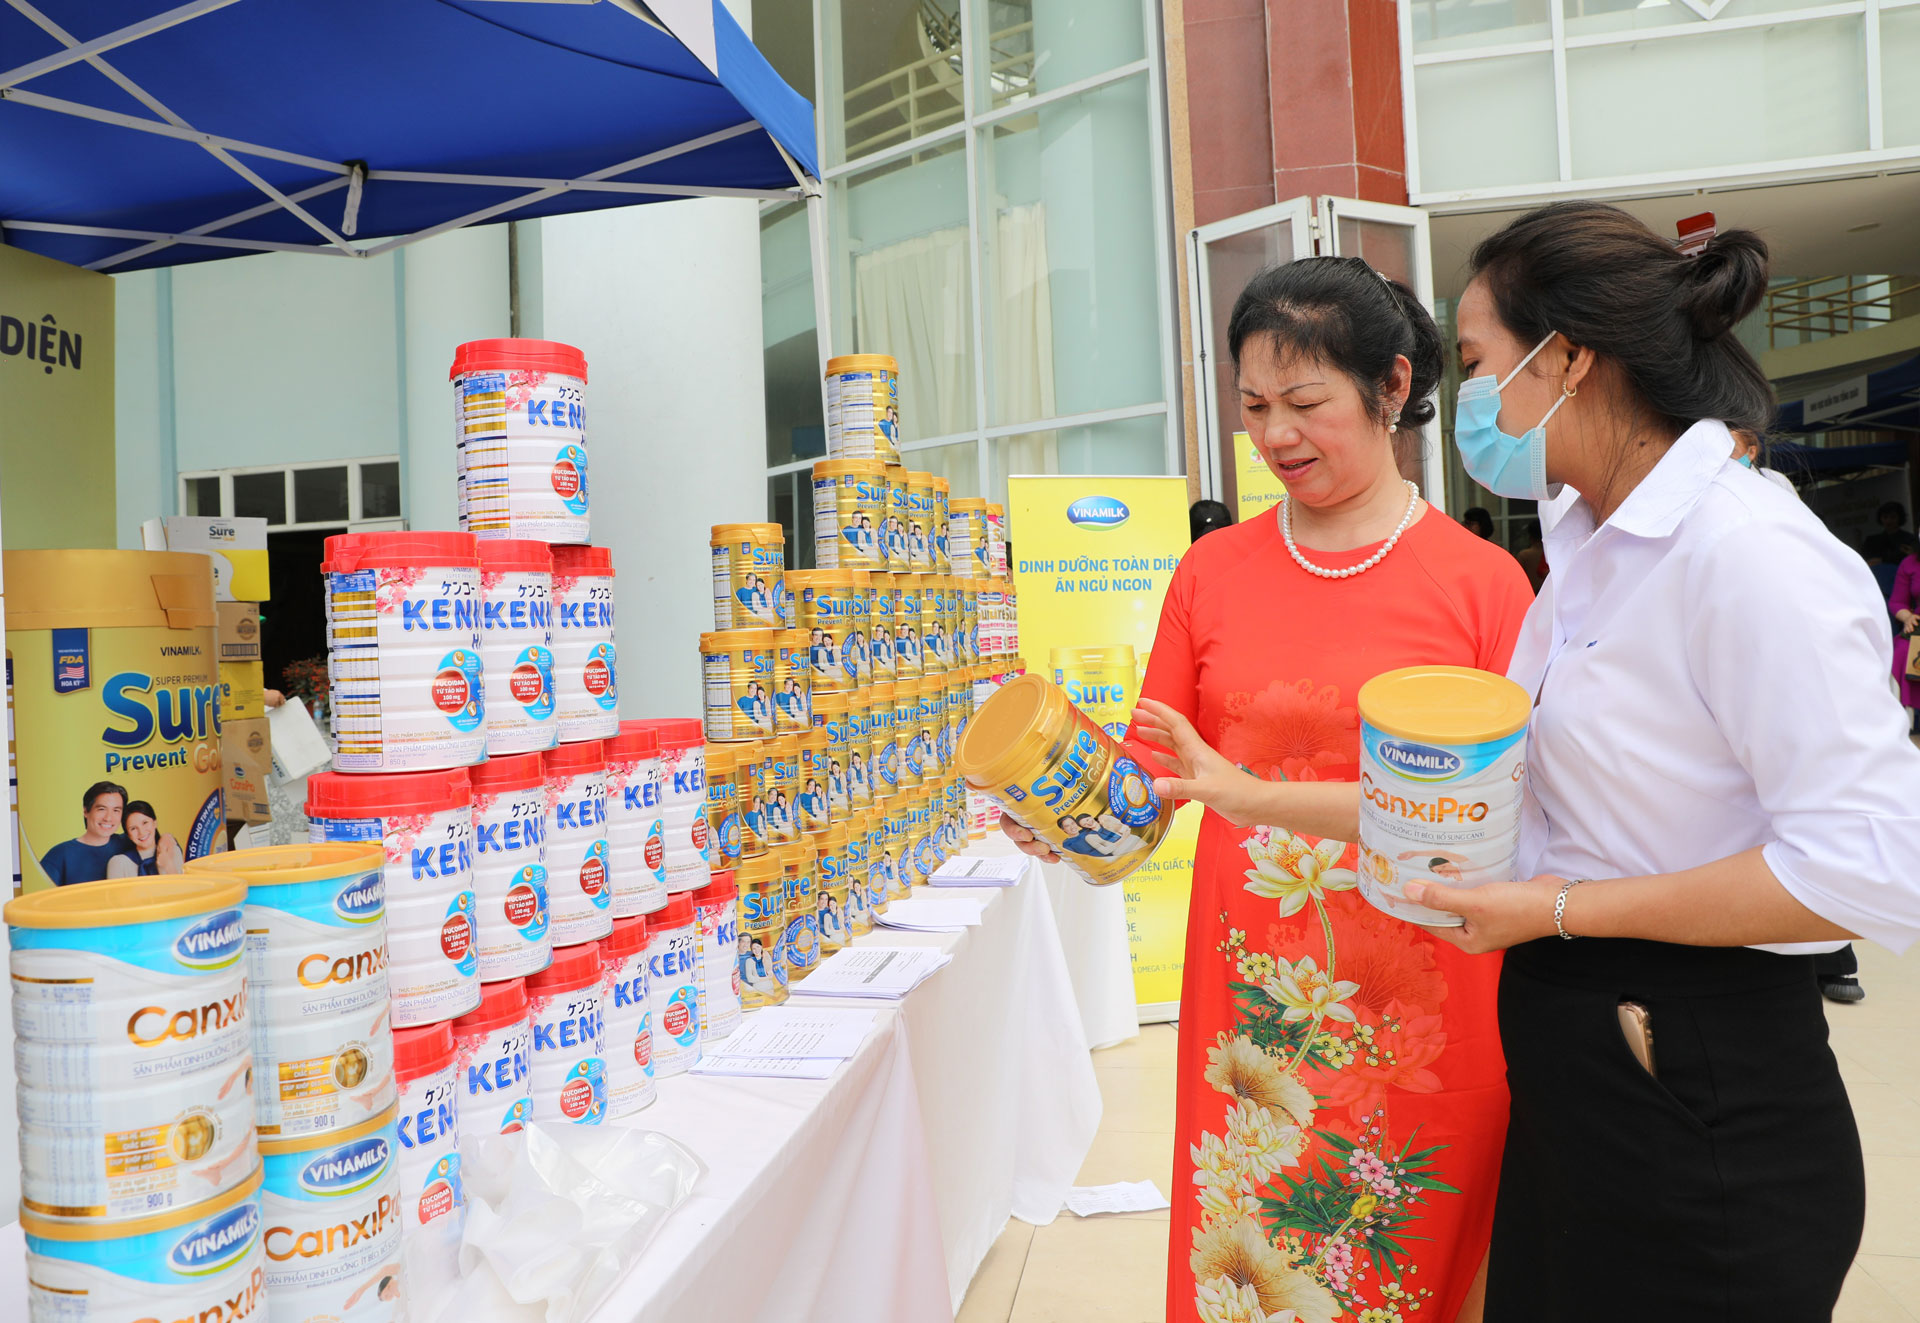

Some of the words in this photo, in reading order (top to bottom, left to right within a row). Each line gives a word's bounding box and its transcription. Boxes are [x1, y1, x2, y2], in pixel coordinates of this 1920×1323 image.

[0, 314, 82, 374] DIỆN
[856, 481, 886, 502] Sur
[893, 488, 908, 507] Su
[909, 493, 934, 511] Sur
[1072, 507, 1126, 518] VINAMILK
[209, 525, 235, 537] Sure
[1019, 560, 1054, 573] DINH
[1058, 555, 1109, 572] DƯỠNG
[1112, 555, 1149, 571] TOÀN
[1055, 577, 1075, 592] ĂN
[1079, 575, 1108, 592] NGỦ
[1112, 578, 1152, 591] NGON
[879, 595, 895, 616] Su
[904, 595, 921, 614] Su
[561, 602, 614, 629] KEN
[59, 655, 84, 664] FDA
[160, 646, 201, 657] VINAMILK
[753, 655, 775, 673] Su
[790, 653, 810, 670] Su
[155, 676, 182, 685] SUPER
[183, 674, 209, 684] PREMIUM
[1066, 680, 1124, 704] Sure
[102, 672, 222, 748] Sure
[897, 707, 920, 723] ure
[920, 697, 942, 717] Sur
[849, 715, 870, 737] Su
[871, 712, 896, 730] ure
[826, 721, 849, 744] Su
[105, 747, 188, 773] Prevent
[812, 754, 829, 771] Su
[1383, 743, 1456, 771] VINAMILK
[774, 761, 798, 780] Sur
[1030, 729, 1097, 807] Sure
[1053, 782, 1089, 816] Prevent
[1087, 743, 1109, 783] Gold
[709, 782, 736, 800] ure
[1361, 771, 1490, 824] CanxiPro
[557, 797, 607, 830] KEN
[194, 822, 203, 840] CHO
[412, 838, 474, 881] KEN
[848, 841, 868, 864] Su
[821, 855, 848, 880] Su
[1163, 856, 1185, 870] GIẤC
[743, 892, 783, 919] Sur
[744, 919, 773, 930] Prevent
[649, 945, 697, 978] KEN
[1137, 965, 1160, 974] OMEGA
[183, 1052, 205, 1069] DINH
[468, 1045, 532, 1096] KEN
[314, 1114, 328, 1128] 900
[330, 1115, 335, 1127] g
[398, 1097, 458, 1149] KEN
[309, 1142, 388, 1183] VINAMILK
[146, 1192, 164, 1208] 900
[167, 1192, 173, 1206] g
[421, 1189, 450, 1206] FUCOIDAN
[180, 1211, 258, 1262] VINAMILK
[309, 1269, 329, 1281] DINH
